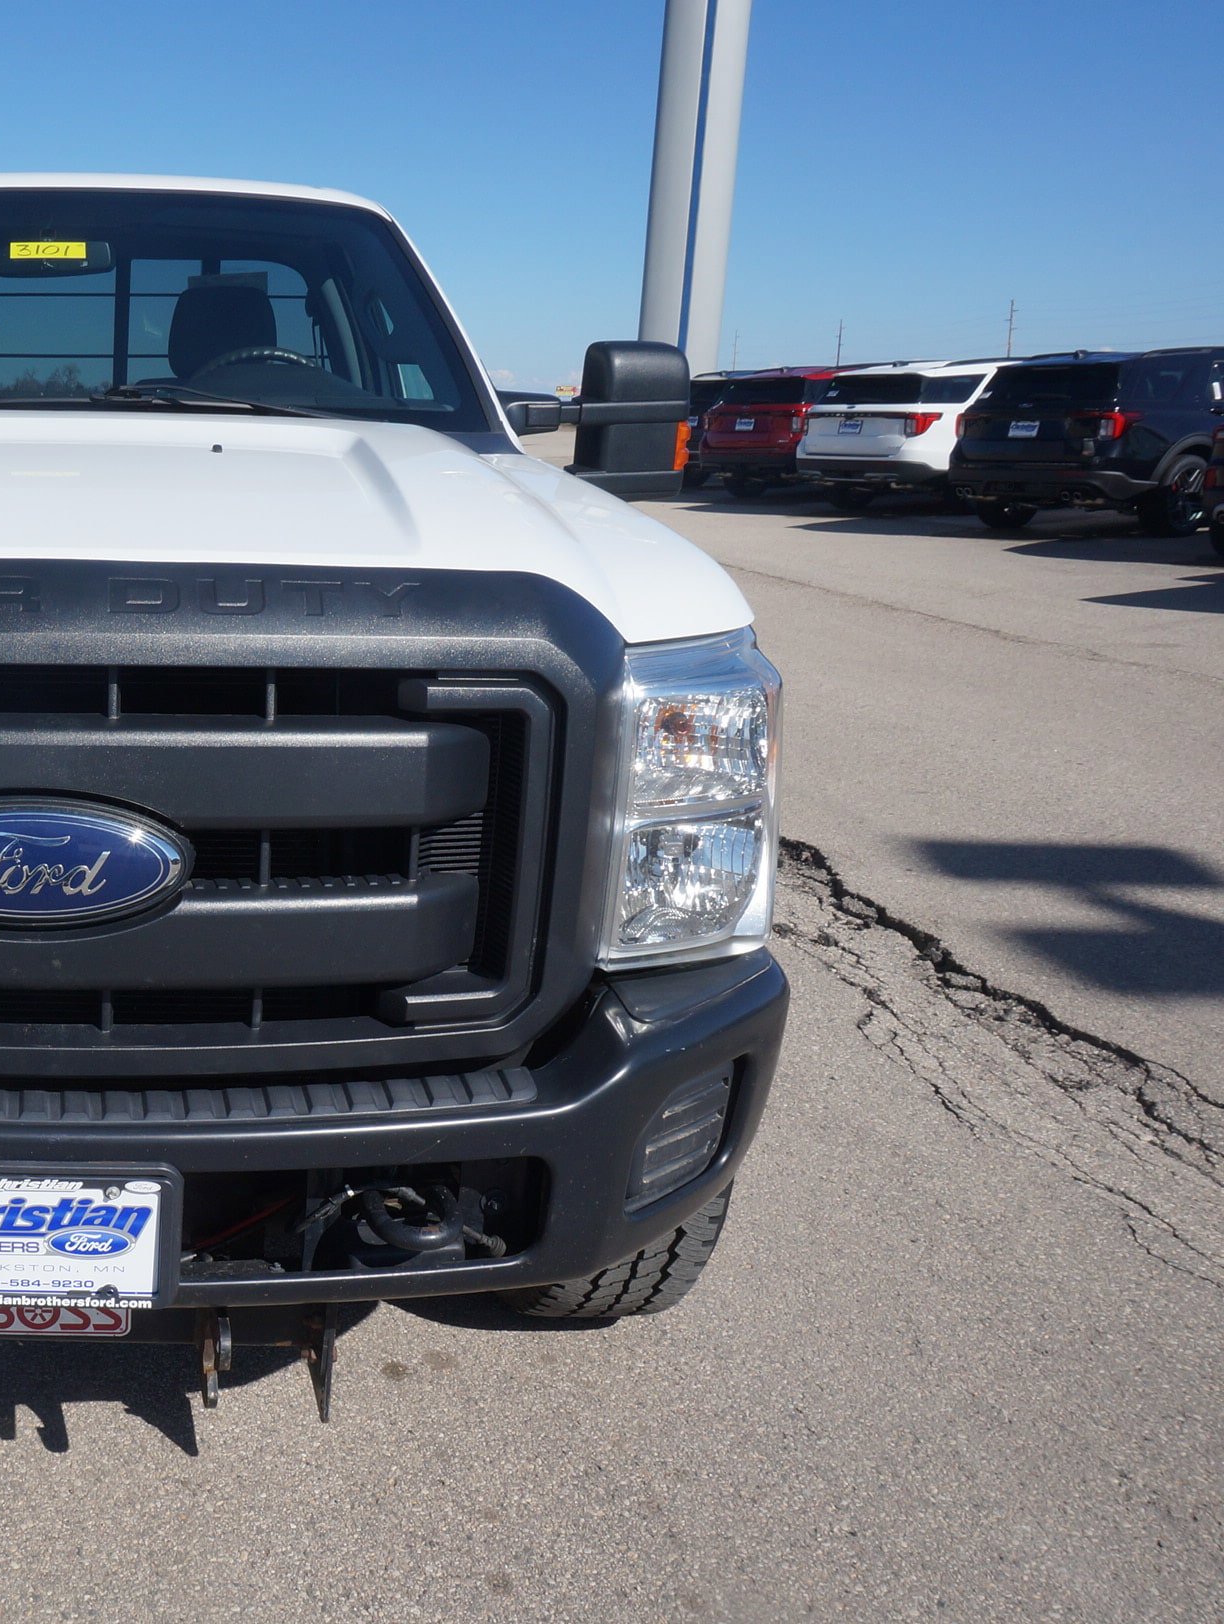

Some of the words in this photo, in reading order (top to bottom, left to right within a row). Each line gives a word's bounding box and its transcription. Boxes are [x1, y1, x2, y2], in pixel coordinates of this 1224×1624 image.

[15, 244, 70, 257] 3101
[108, 576, 422, 616] DUTY
[64, 1231, 114, 1253] Ford
[93, 1264, 127, 1273] MN
